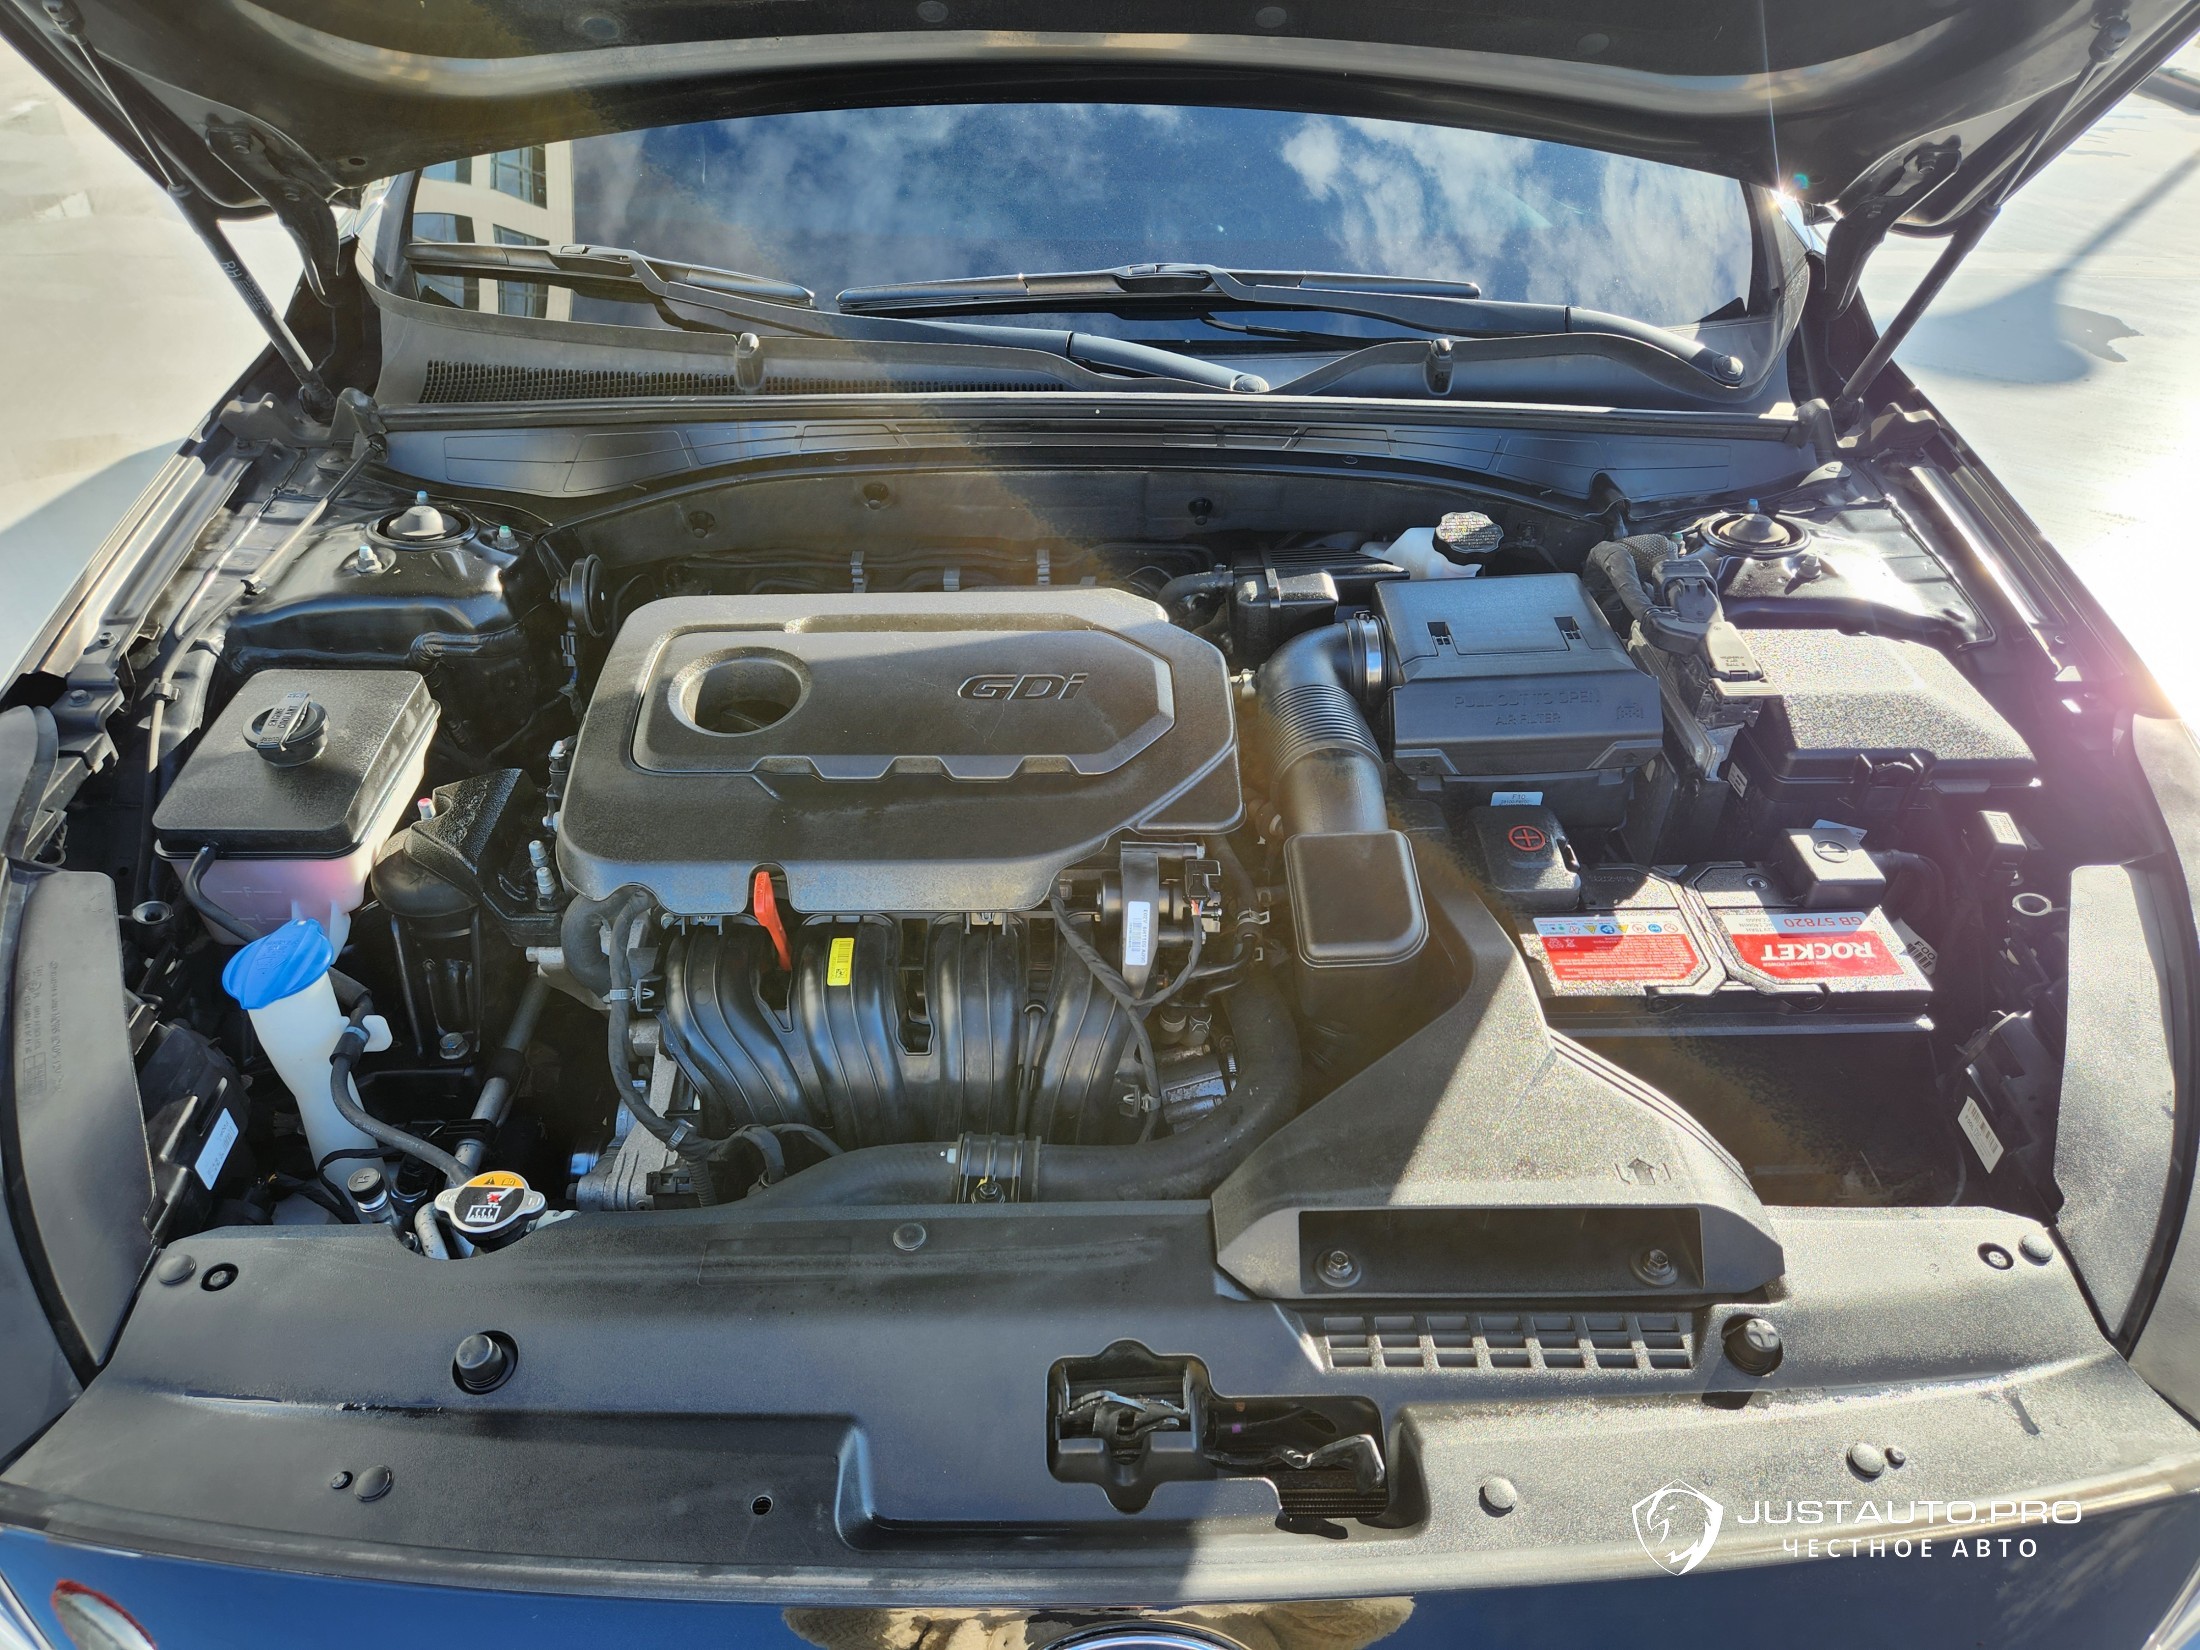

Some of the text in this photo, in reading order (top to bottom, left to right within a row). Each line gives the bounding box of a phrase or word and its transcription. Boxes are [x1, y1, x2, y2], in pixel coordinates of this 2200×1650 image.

[220, 260, 243, 278] RH
[957, 672, 1089, 701] GDi
[1454, 694, 1494, 709] PULL
[1783, 916, 1863, 928] GB 57820
[1760, 941, 1877, 961] ROCKET
